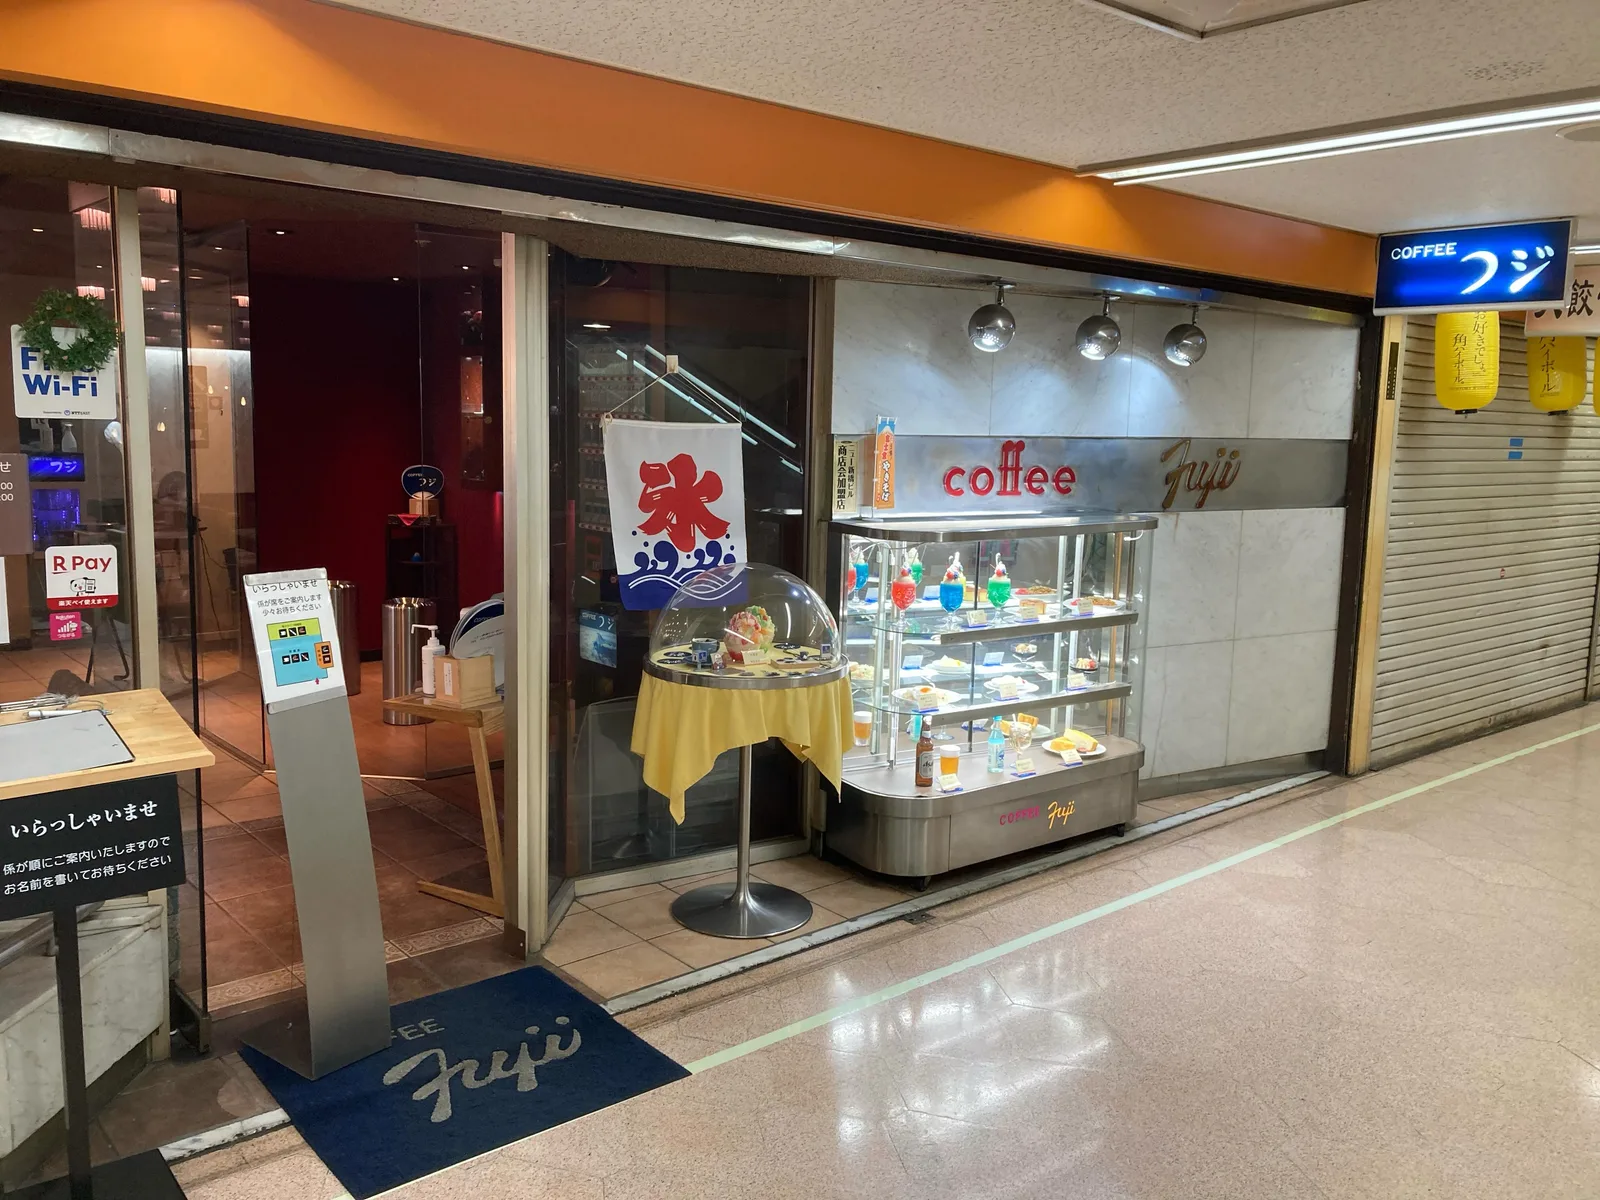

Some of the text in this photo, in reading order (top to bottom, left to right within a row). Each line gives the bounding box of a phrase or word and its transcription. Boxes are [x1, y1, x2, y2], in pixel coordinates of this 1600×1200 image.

[1391, 242, 1457, 260] COFFEE
[1460, 245, 1555, 295] フジ
[22, 373, 98, 397] Wi-Fi
[50, 461, 77, 473] フジ
[837, 445, 847, 510] 商店会加盟店
[943, 439, 1077, 497] coffee
[1161, 438, 1242, 510] Fuji
[637, 453, 731, 553] 氷
[52, 556, 112, 574] R Pay
[252, 579, 318, 593] いらっしゃいませ
[257, 594, 322, 608] 係が席をご案内します
[262, 603, 322, 617] 少々お待ちください
[11, 800, 157, 838] いらっしゃいませ
[999, 800, 1076, 829] COFFEE Fuji
[3, 836, 171, 876] 係が順にご案内いたしますので
[4, 855, 172, 895] お名前を書いてお待ちください
[391, 1018, 445, 1040] EE
[383, 1016, 582, 1123] Fuji
